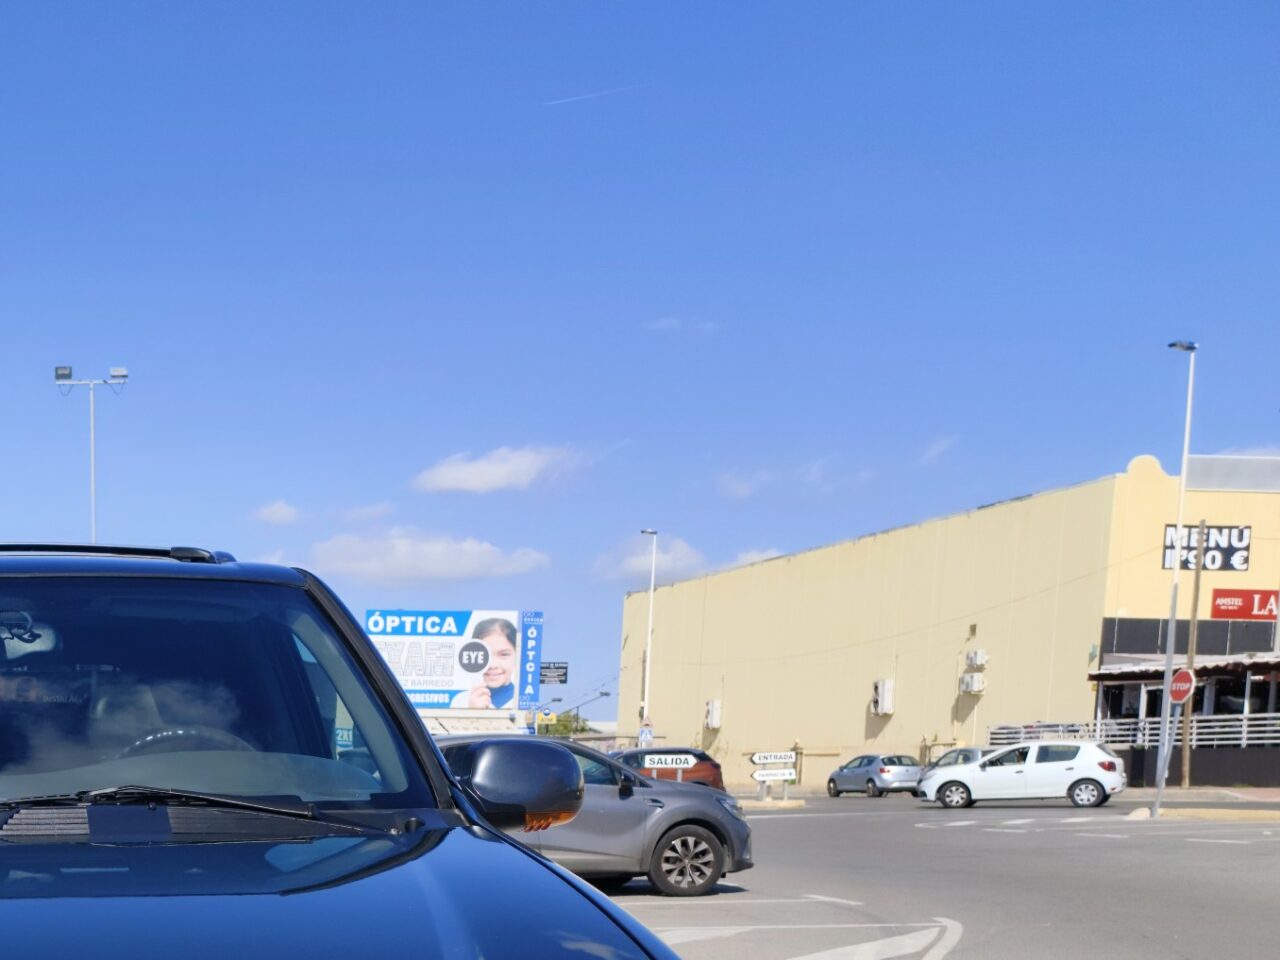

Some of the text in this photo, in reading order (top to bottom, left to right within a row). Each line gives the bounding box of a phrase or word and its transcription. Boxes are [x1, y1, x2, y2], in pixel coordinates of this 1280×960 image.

[1215, 597, 1243, 606] AMSTEL
[368, 611, 458, 633] ÓPTICA
[462, 651, 485, 664] EYE
[1172, 683, 1190, 691] STOP
[649, 757, 690, 765] SALIDA
